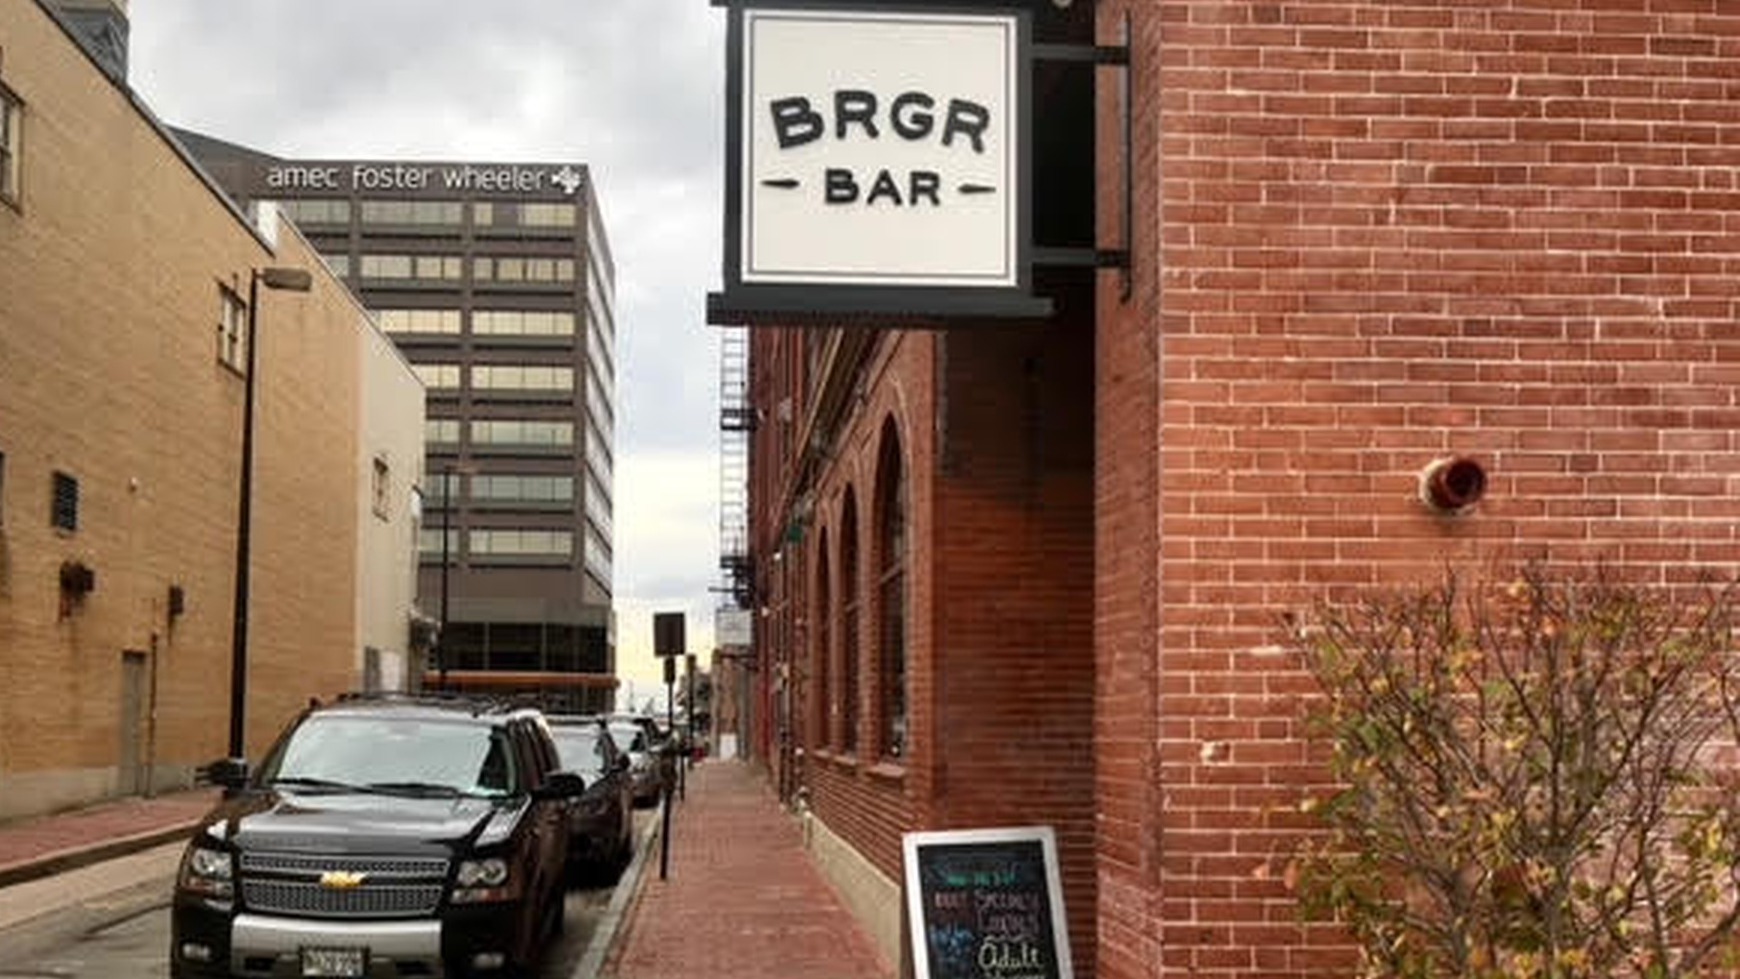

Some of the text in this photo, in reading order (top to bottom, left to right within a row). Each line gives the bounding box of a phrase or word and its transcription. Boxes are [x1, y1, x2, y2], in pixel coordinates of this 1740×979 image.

[770, 90, 990, 154] BRGR
[266, 164, 545, 191] amec foster wheeler
[825, 168, 941, 206] BAR
